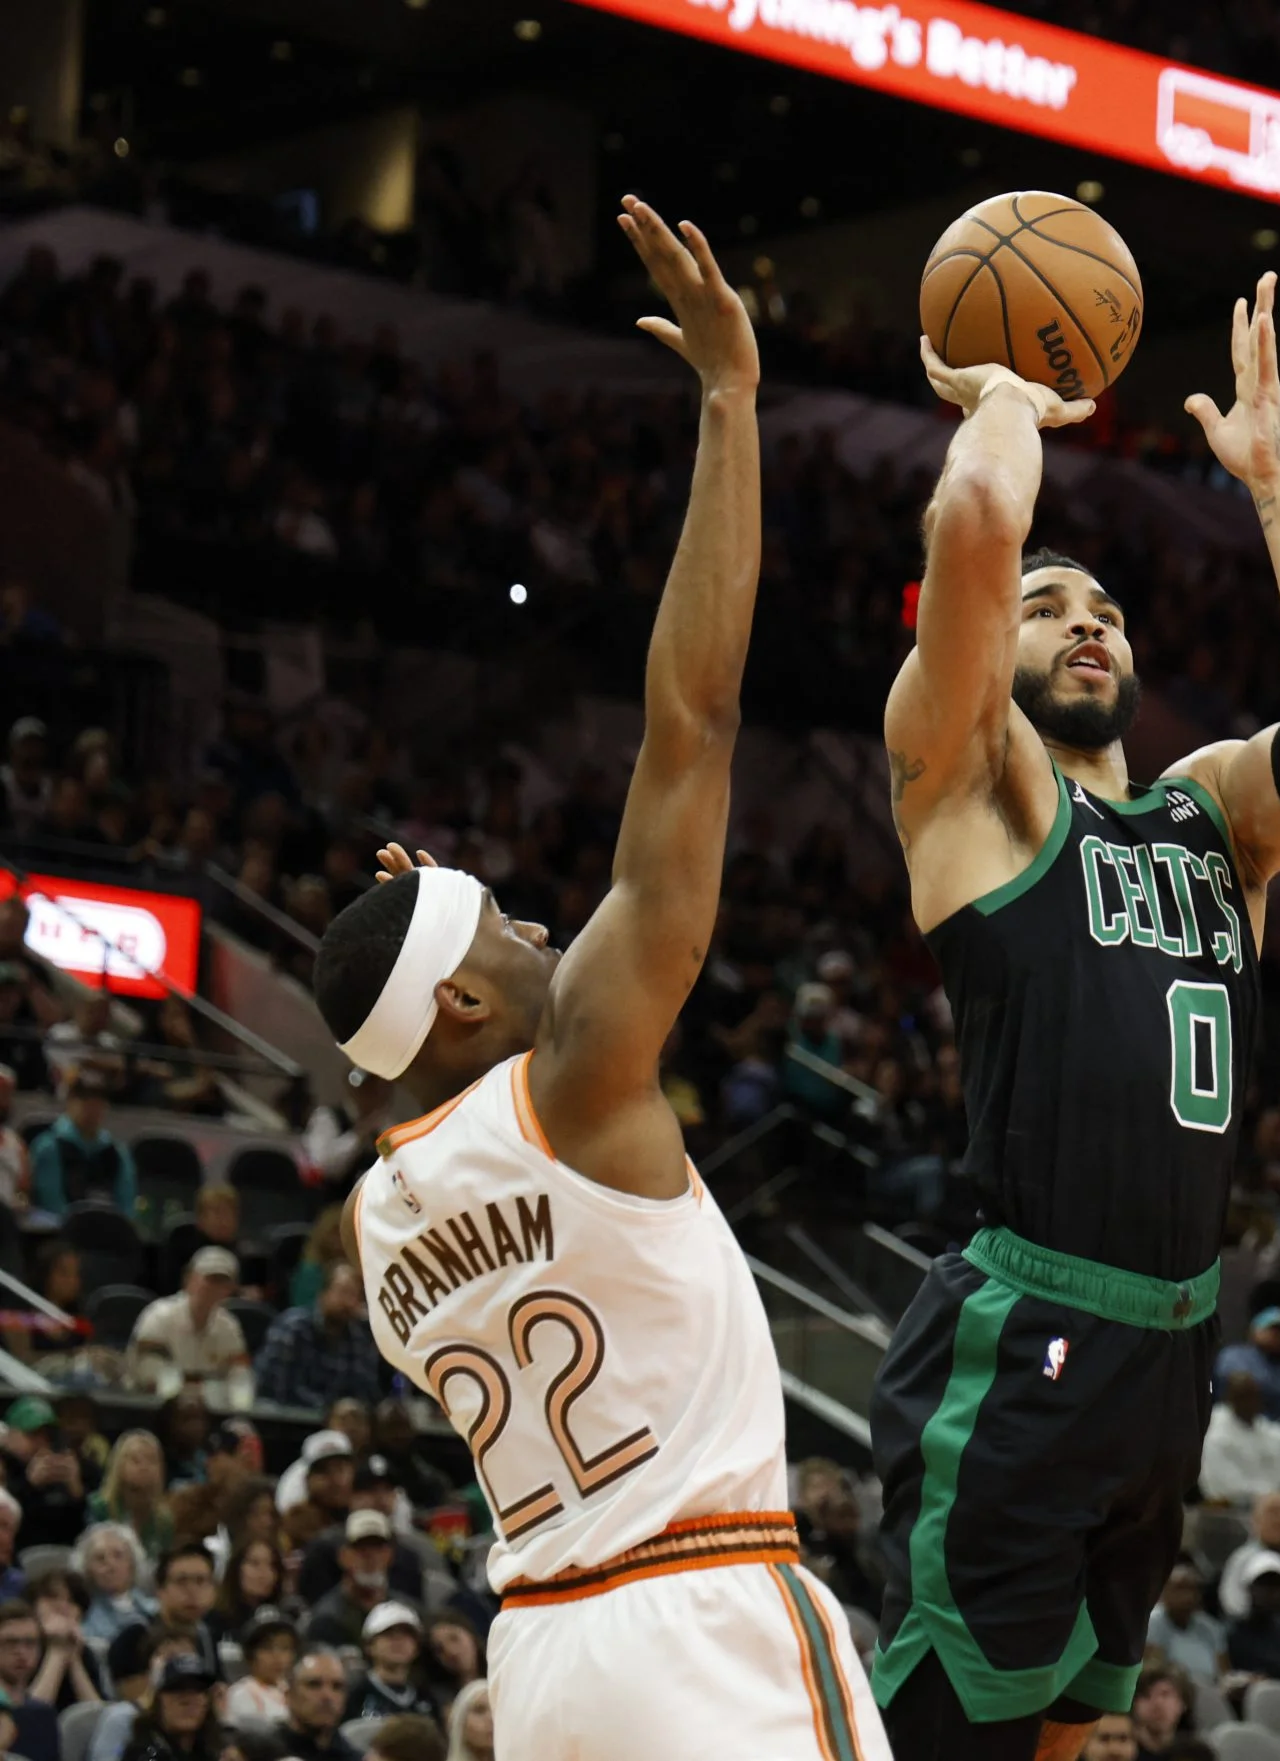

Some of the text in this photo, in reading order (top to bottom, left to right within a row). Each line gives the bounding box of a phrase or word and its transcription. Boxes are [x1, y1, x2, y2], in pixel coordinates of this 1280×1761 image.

[926, 17, 1077, 111] Better
[1166, 979, 1232, 1134] 0
[378, 1193, 554, 1348] BRANHAM
[424, 1289, 660, 1543] 22
